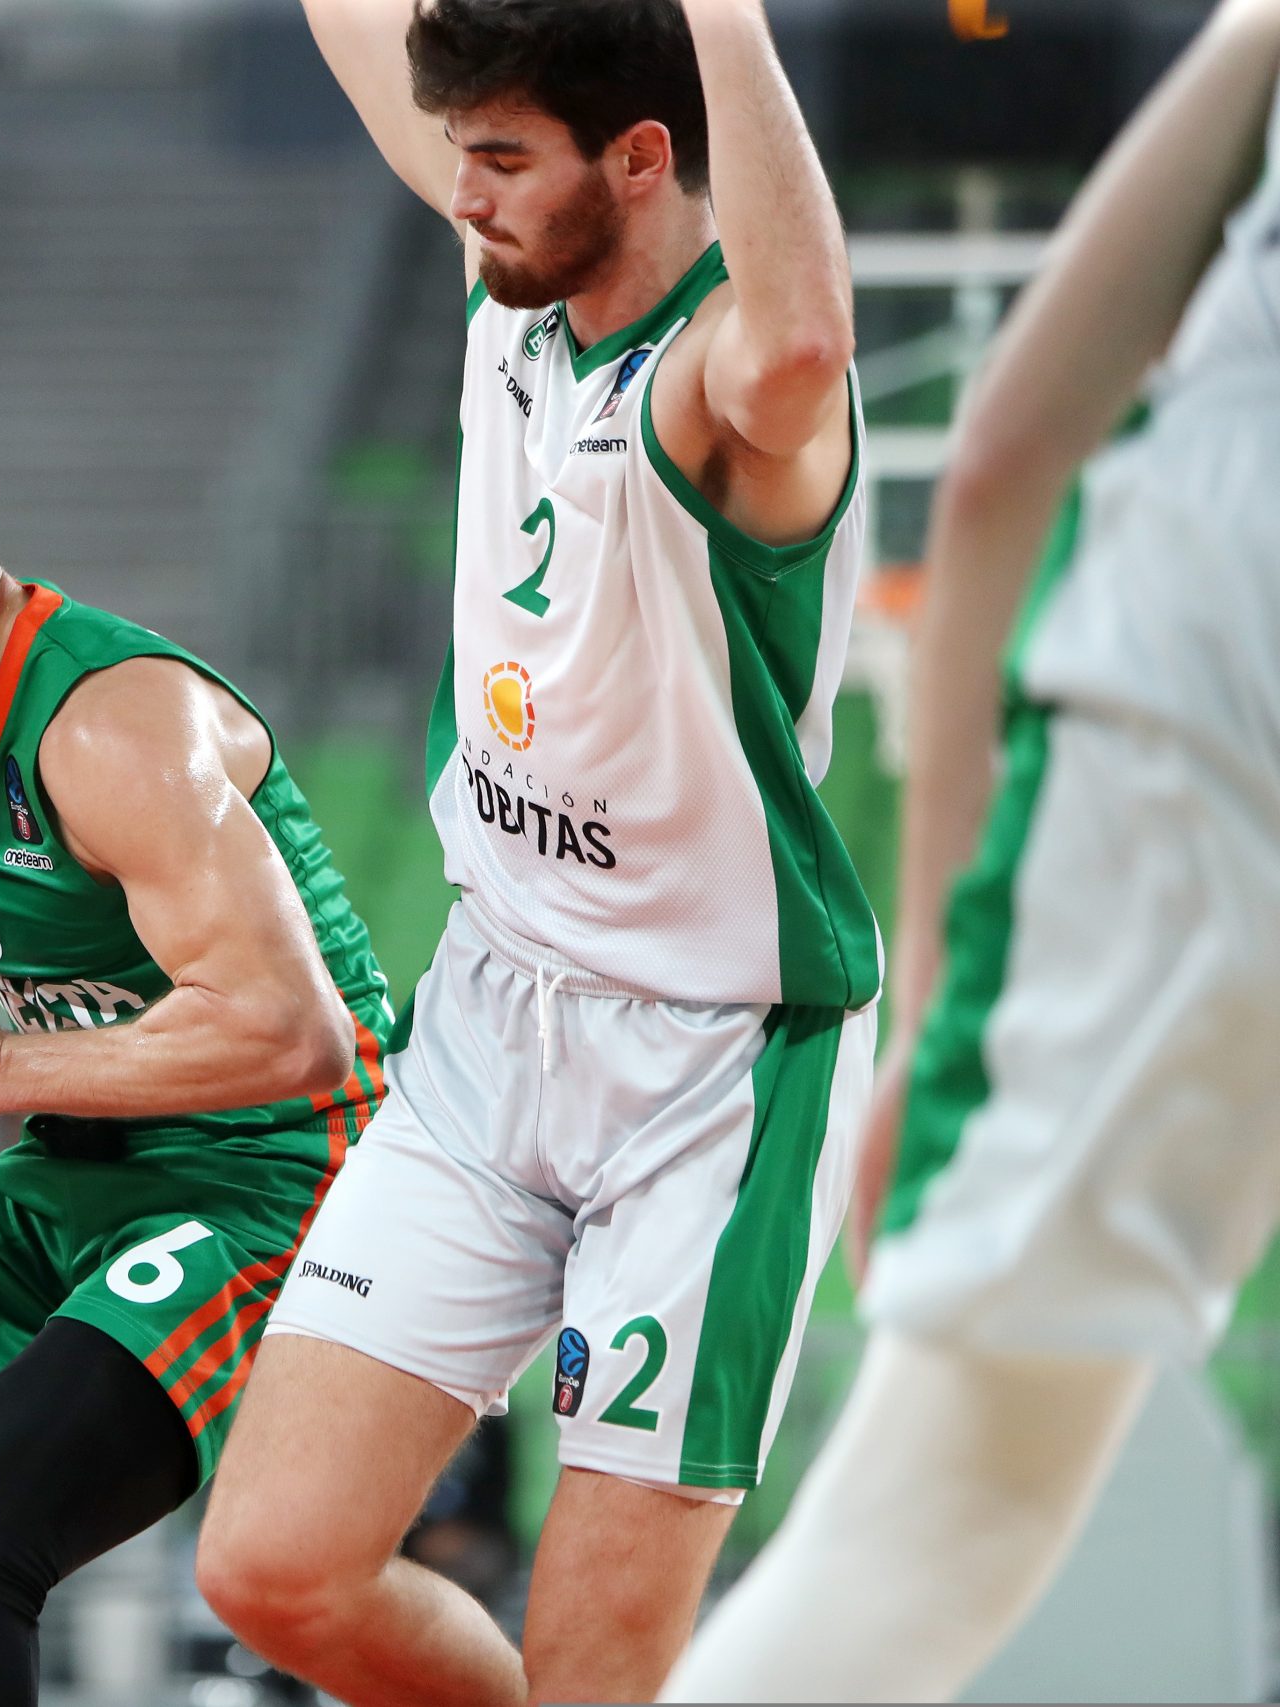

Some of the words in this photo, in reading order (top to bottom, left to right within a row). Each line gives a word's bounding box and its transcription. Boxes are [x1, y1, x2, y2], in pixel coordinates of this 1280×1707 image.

[497, 355, 533, 418] SDING
[502, 497, 555, 618] 2
[458, 727, 607, 814] NDACIÓN
[461, 752, 617, 870] OBITAS
[4, 848, 54, 871] oneteam
[105, 1220, 214, 1304] 6
[298, 1260, 373, 1298] SPALDING
[598, 1315, 668, 1432] 2
